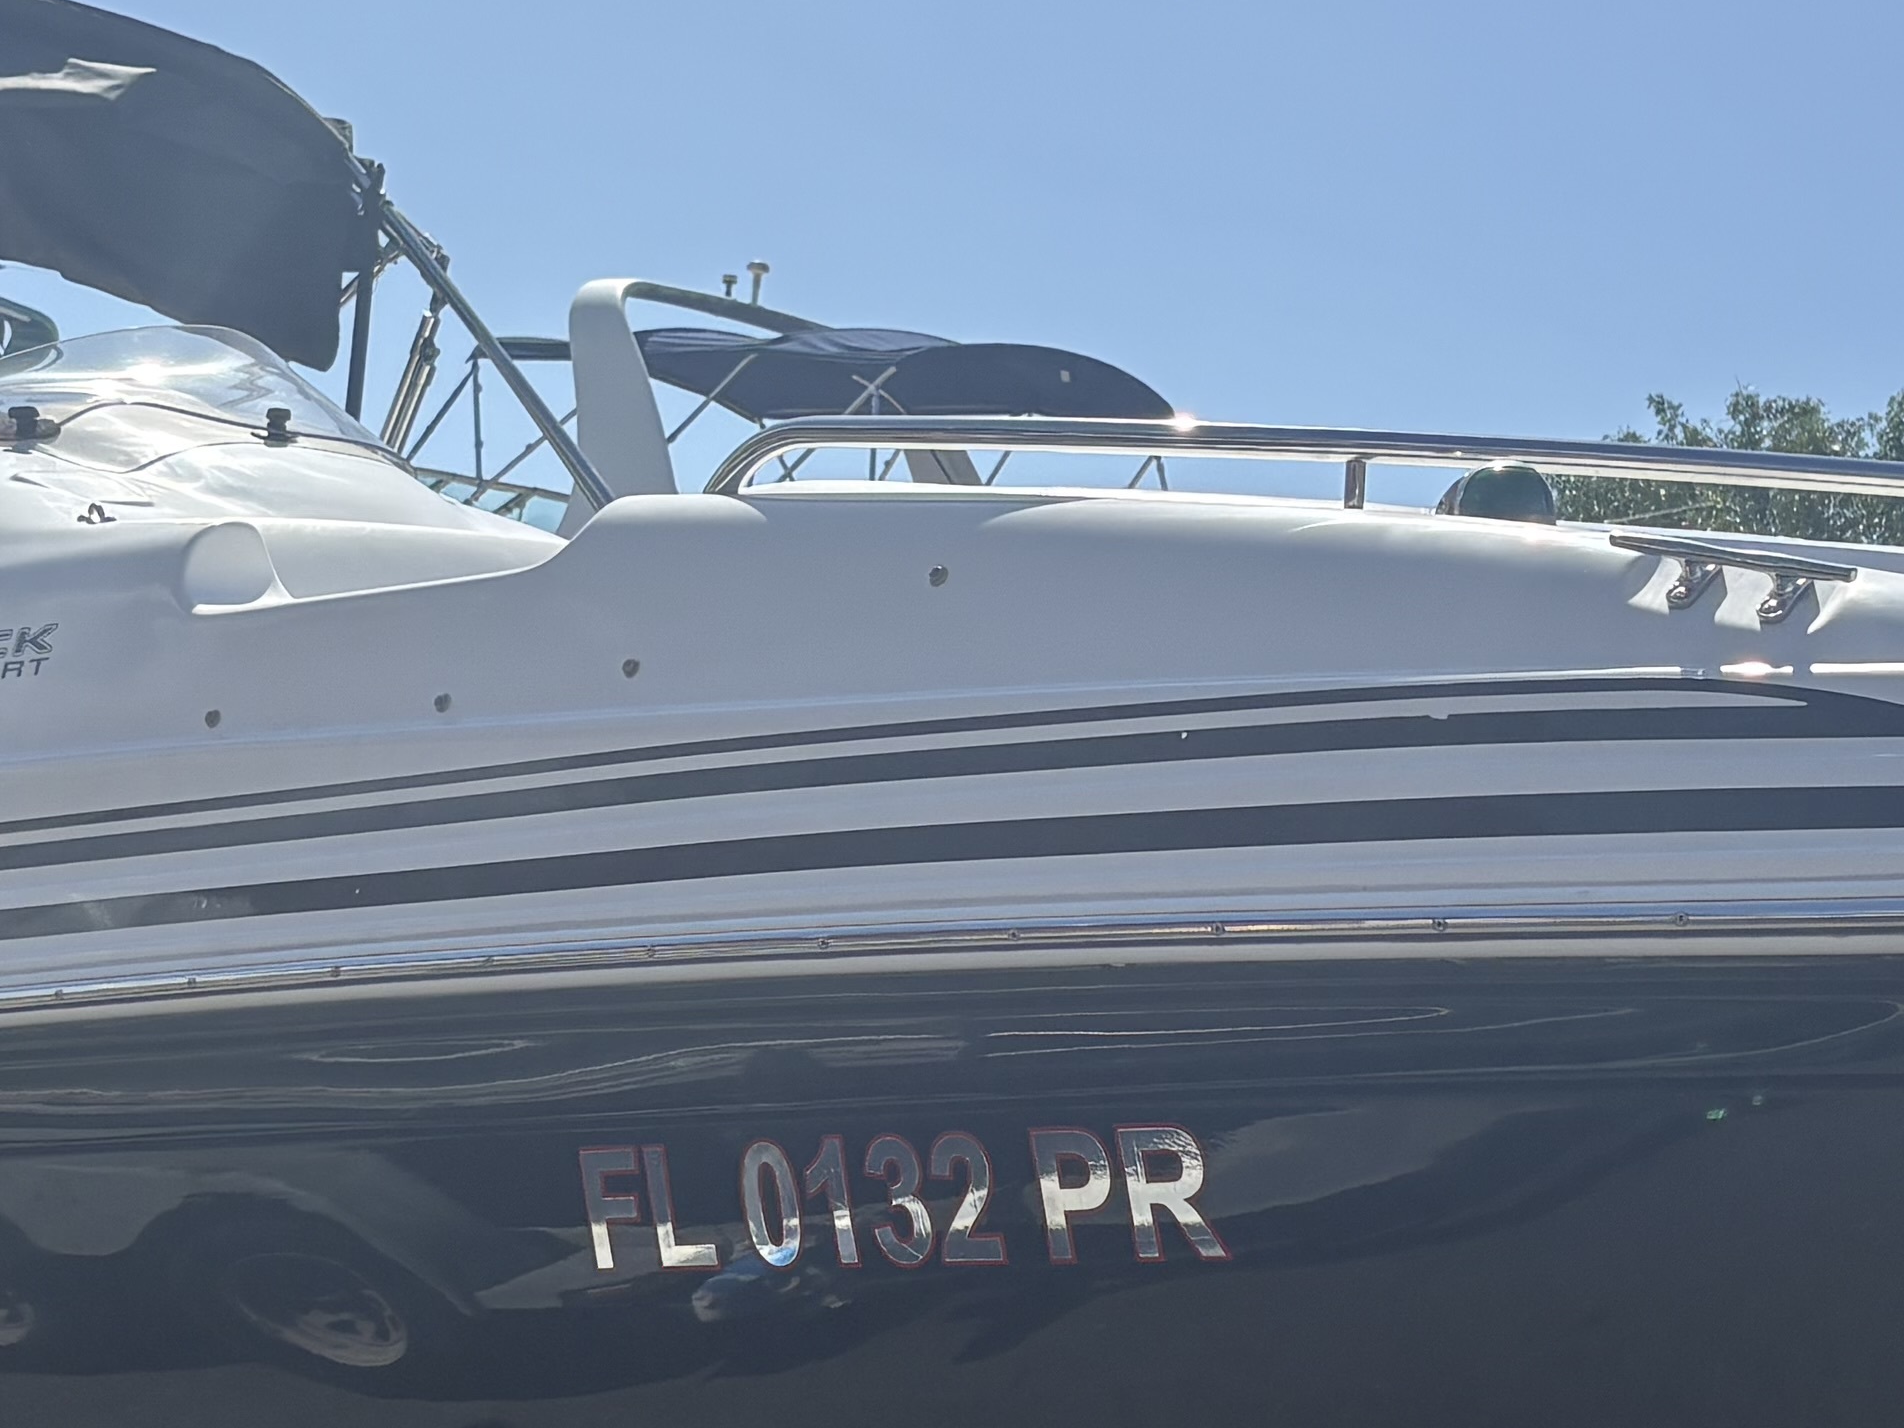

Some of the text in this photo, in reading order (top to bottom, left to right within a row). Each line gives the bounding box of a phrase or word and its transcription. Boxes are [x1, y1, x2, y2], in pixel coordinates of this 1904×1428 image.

[578, 1121, 1234, 1272] FL 0132 PR
